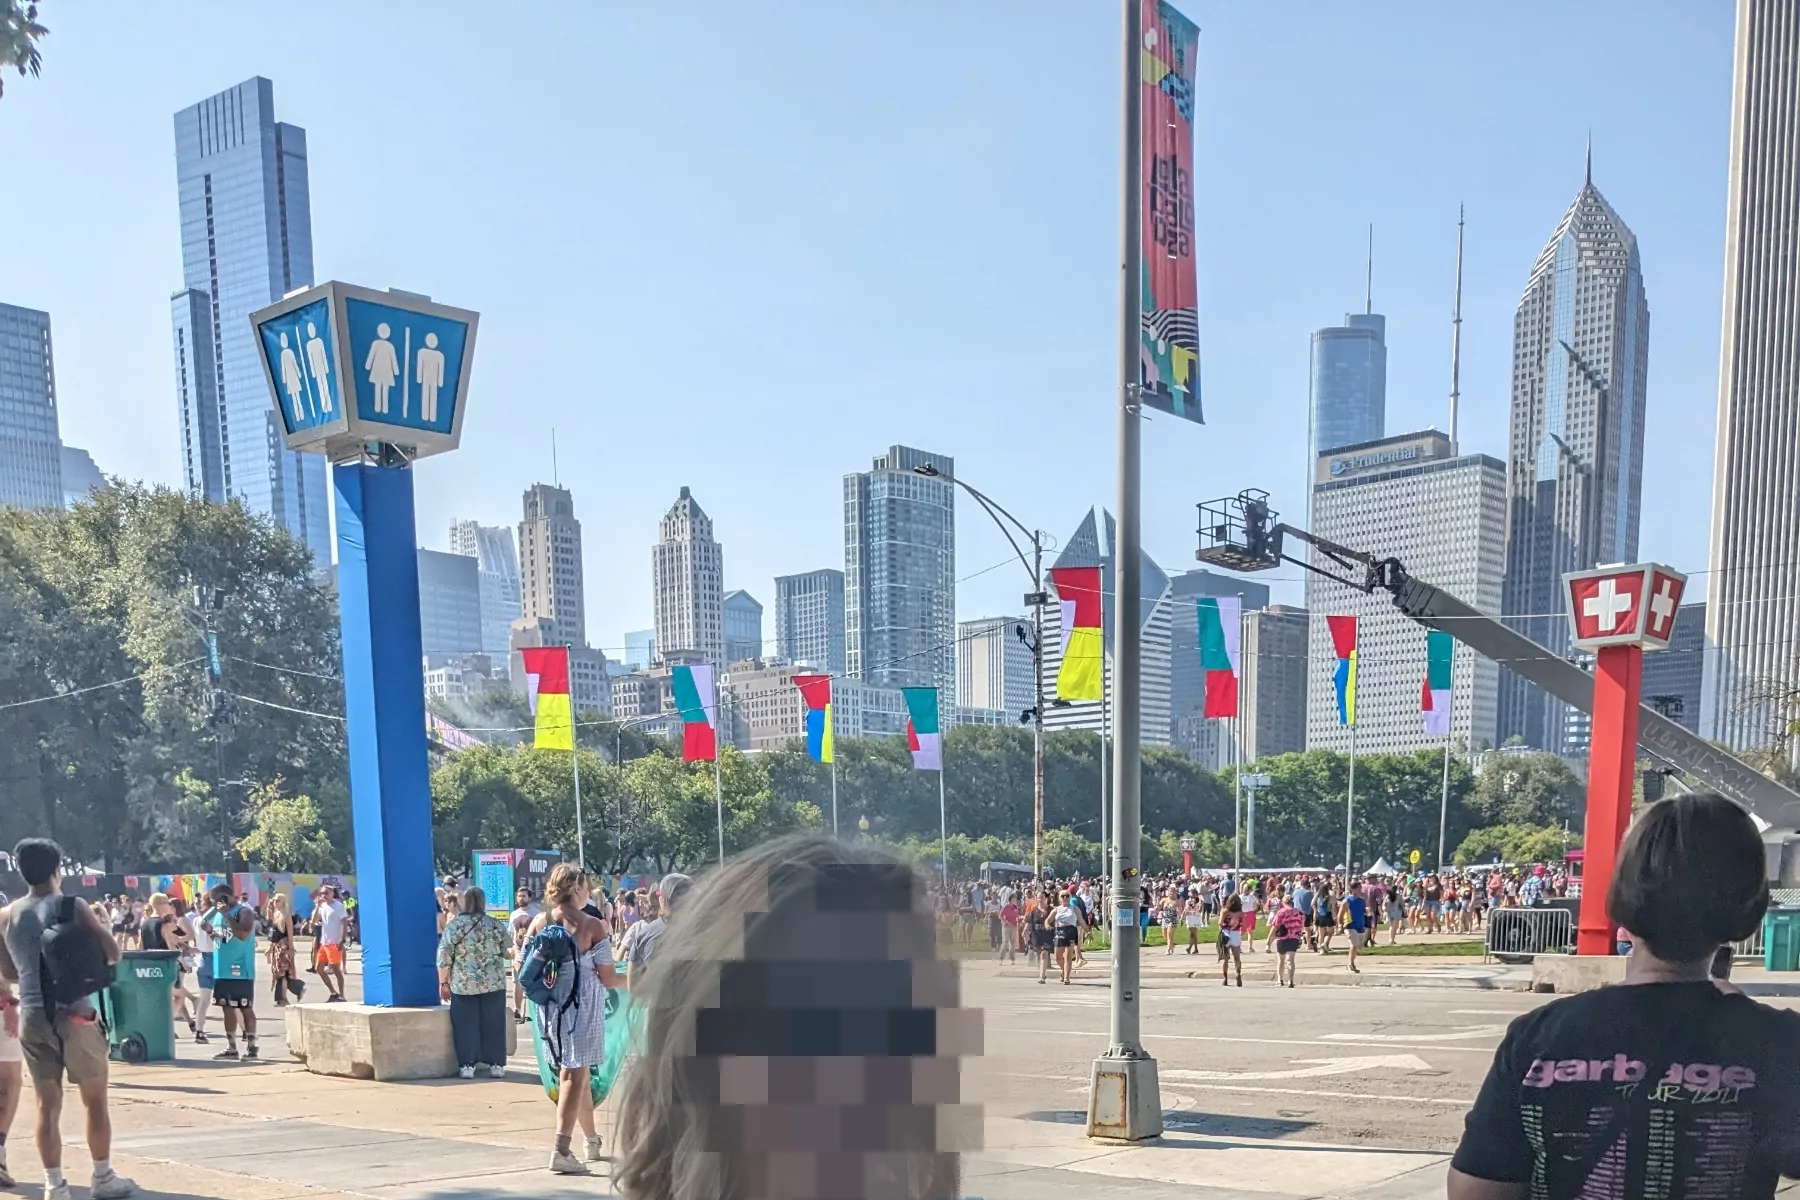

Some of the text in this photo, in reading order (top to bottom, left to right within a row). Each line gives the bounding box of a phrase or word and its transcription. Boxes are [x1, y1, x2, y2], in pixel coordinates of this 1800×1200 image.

[1349, 446, 1417, 469] Prudential
[529, 859, 548, 873] MAP
[136, 967, 163, 978] WM
